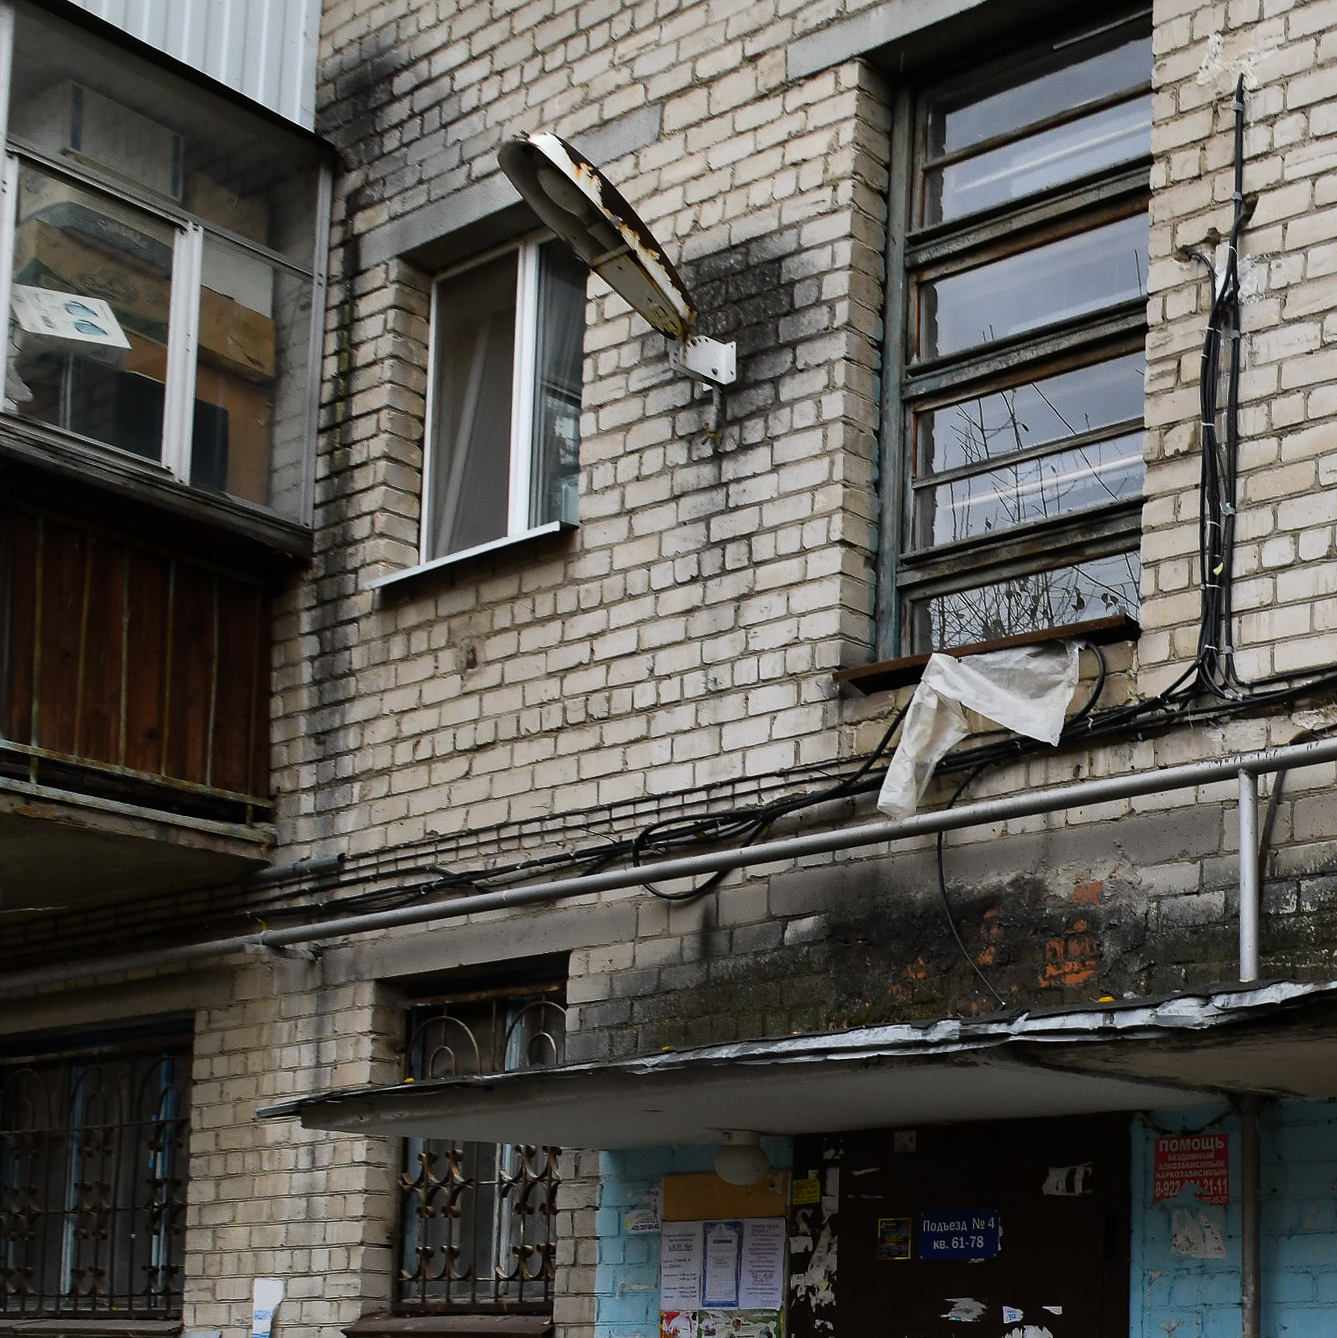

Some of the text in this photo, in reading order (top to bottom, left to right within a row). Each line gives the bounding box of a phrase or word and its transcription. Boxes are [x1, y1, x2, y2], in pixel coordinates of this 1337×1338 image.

[1159, 1137, 1225, 1152] ПОМОЩЬ
[922, 1216, 995, 1233] Подъезд № 4
[933, 1235, 985, 1250] кв. 61-78
